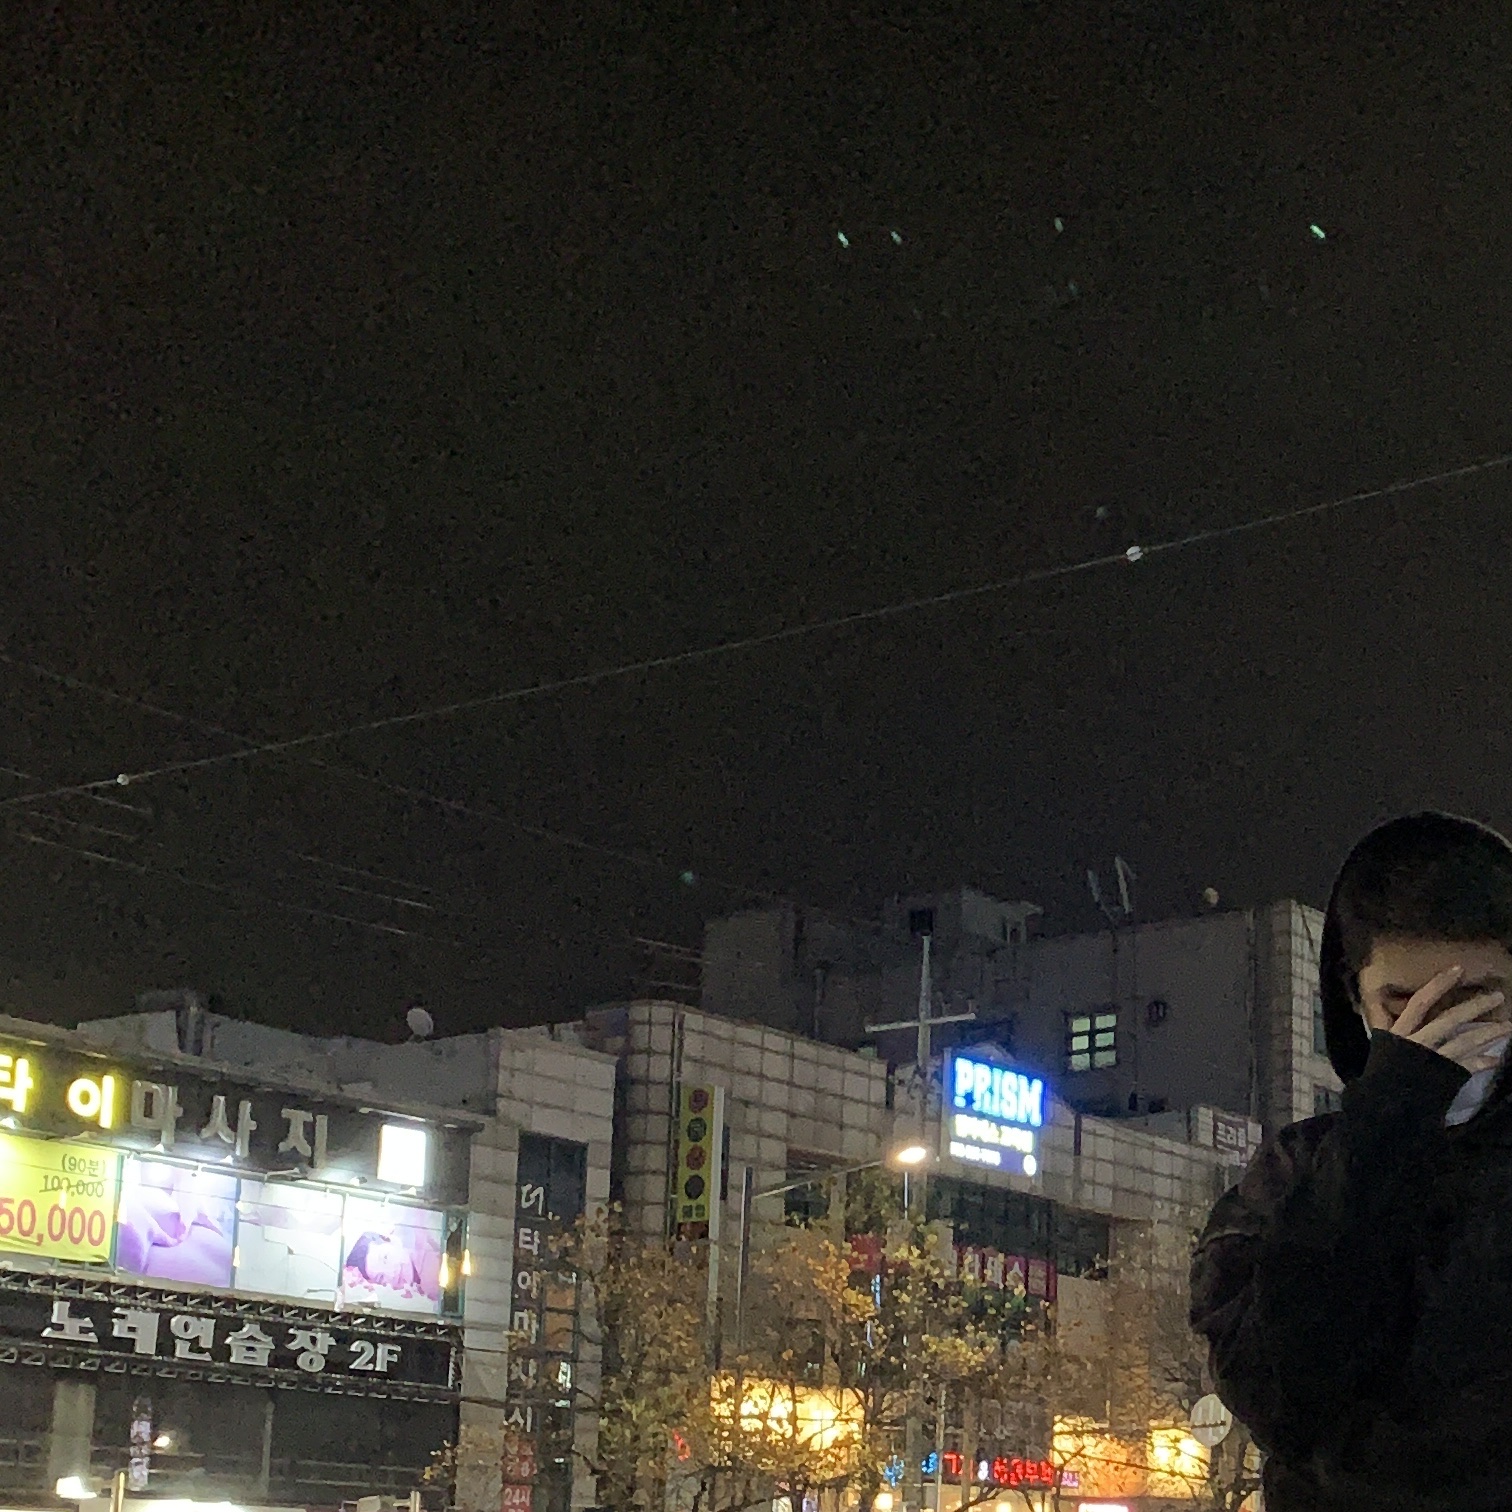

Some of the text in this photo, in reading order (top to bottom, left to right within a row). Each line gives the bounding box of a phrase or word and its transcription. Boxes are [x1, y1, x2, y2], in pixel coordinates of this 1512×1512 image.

[954, 1056, 1044, 1127] PRISM
[41, 1300, 402, 1373] 노래연습장 2F
